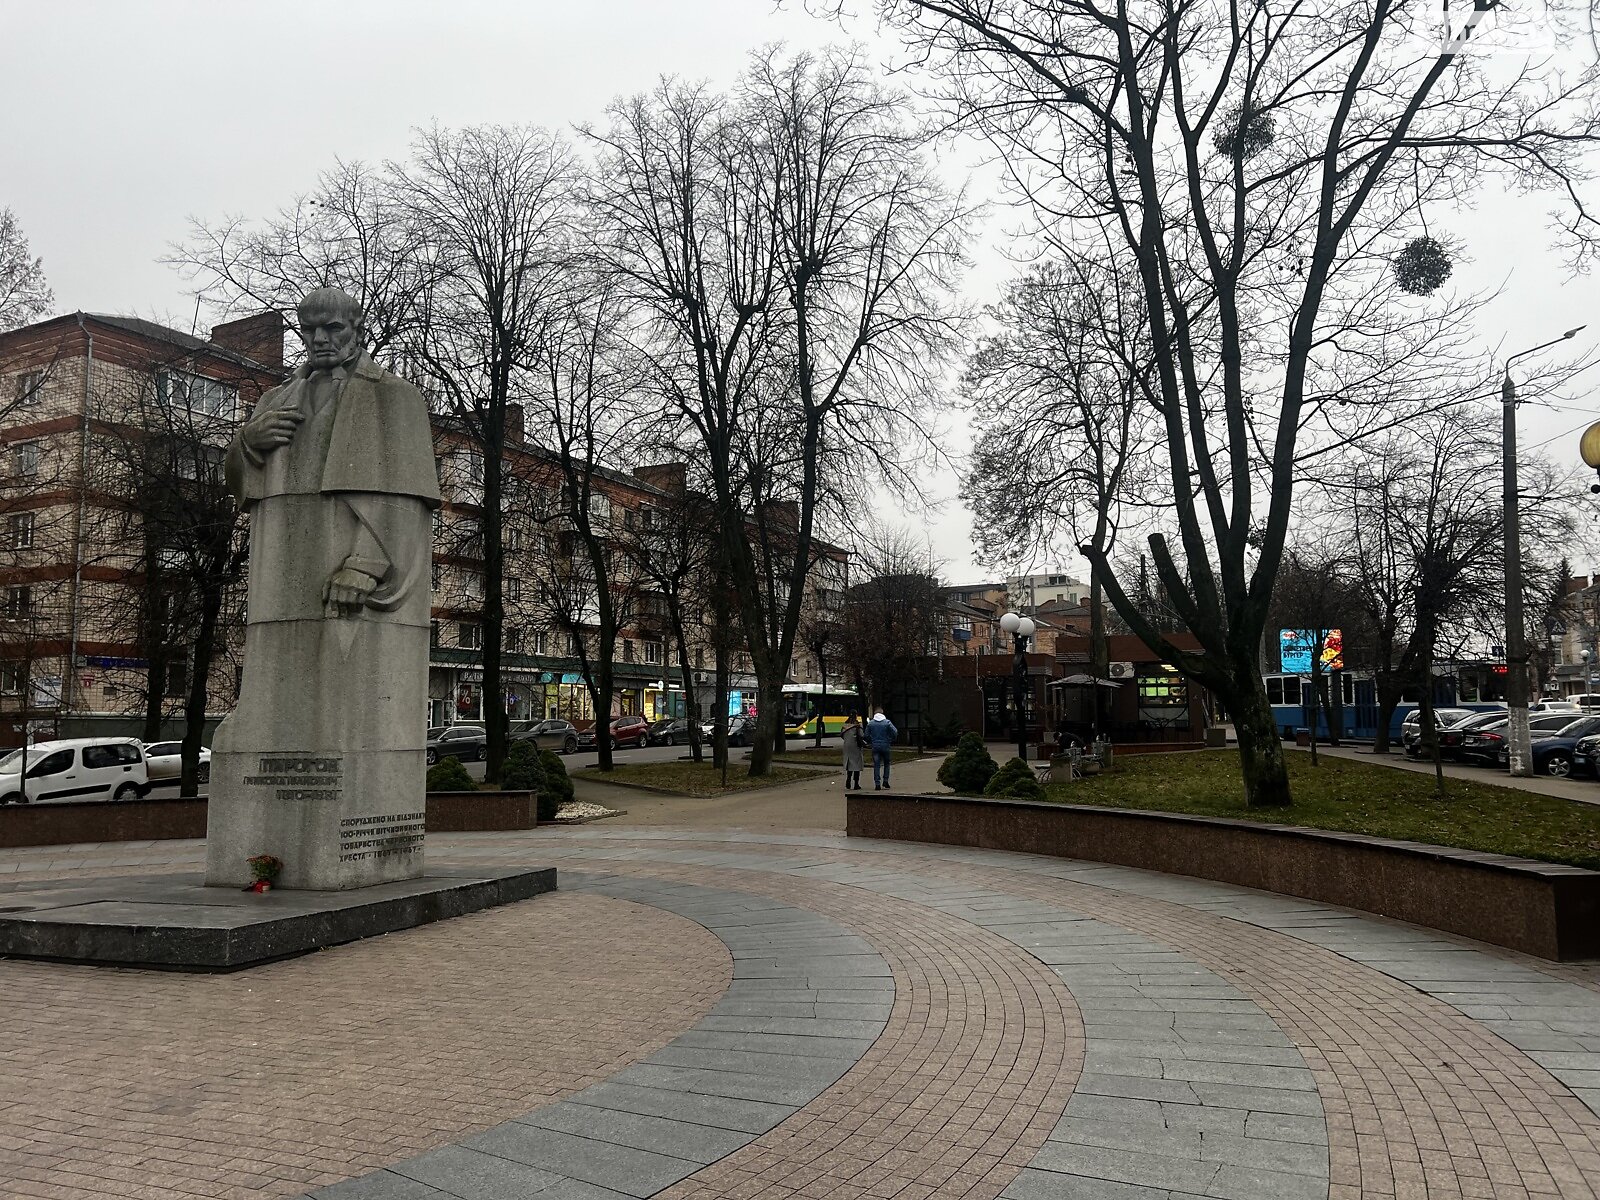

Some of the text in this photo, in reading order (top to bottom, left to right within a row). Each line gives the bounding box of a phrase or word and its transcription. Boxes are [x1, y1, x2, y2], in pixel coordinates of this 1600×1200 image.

[341, 816, 386, 827] СПОРУДЖЕНО
[387, 815, 395, 823] НА
[339, 852, 366, 862] ХРЕСТА
